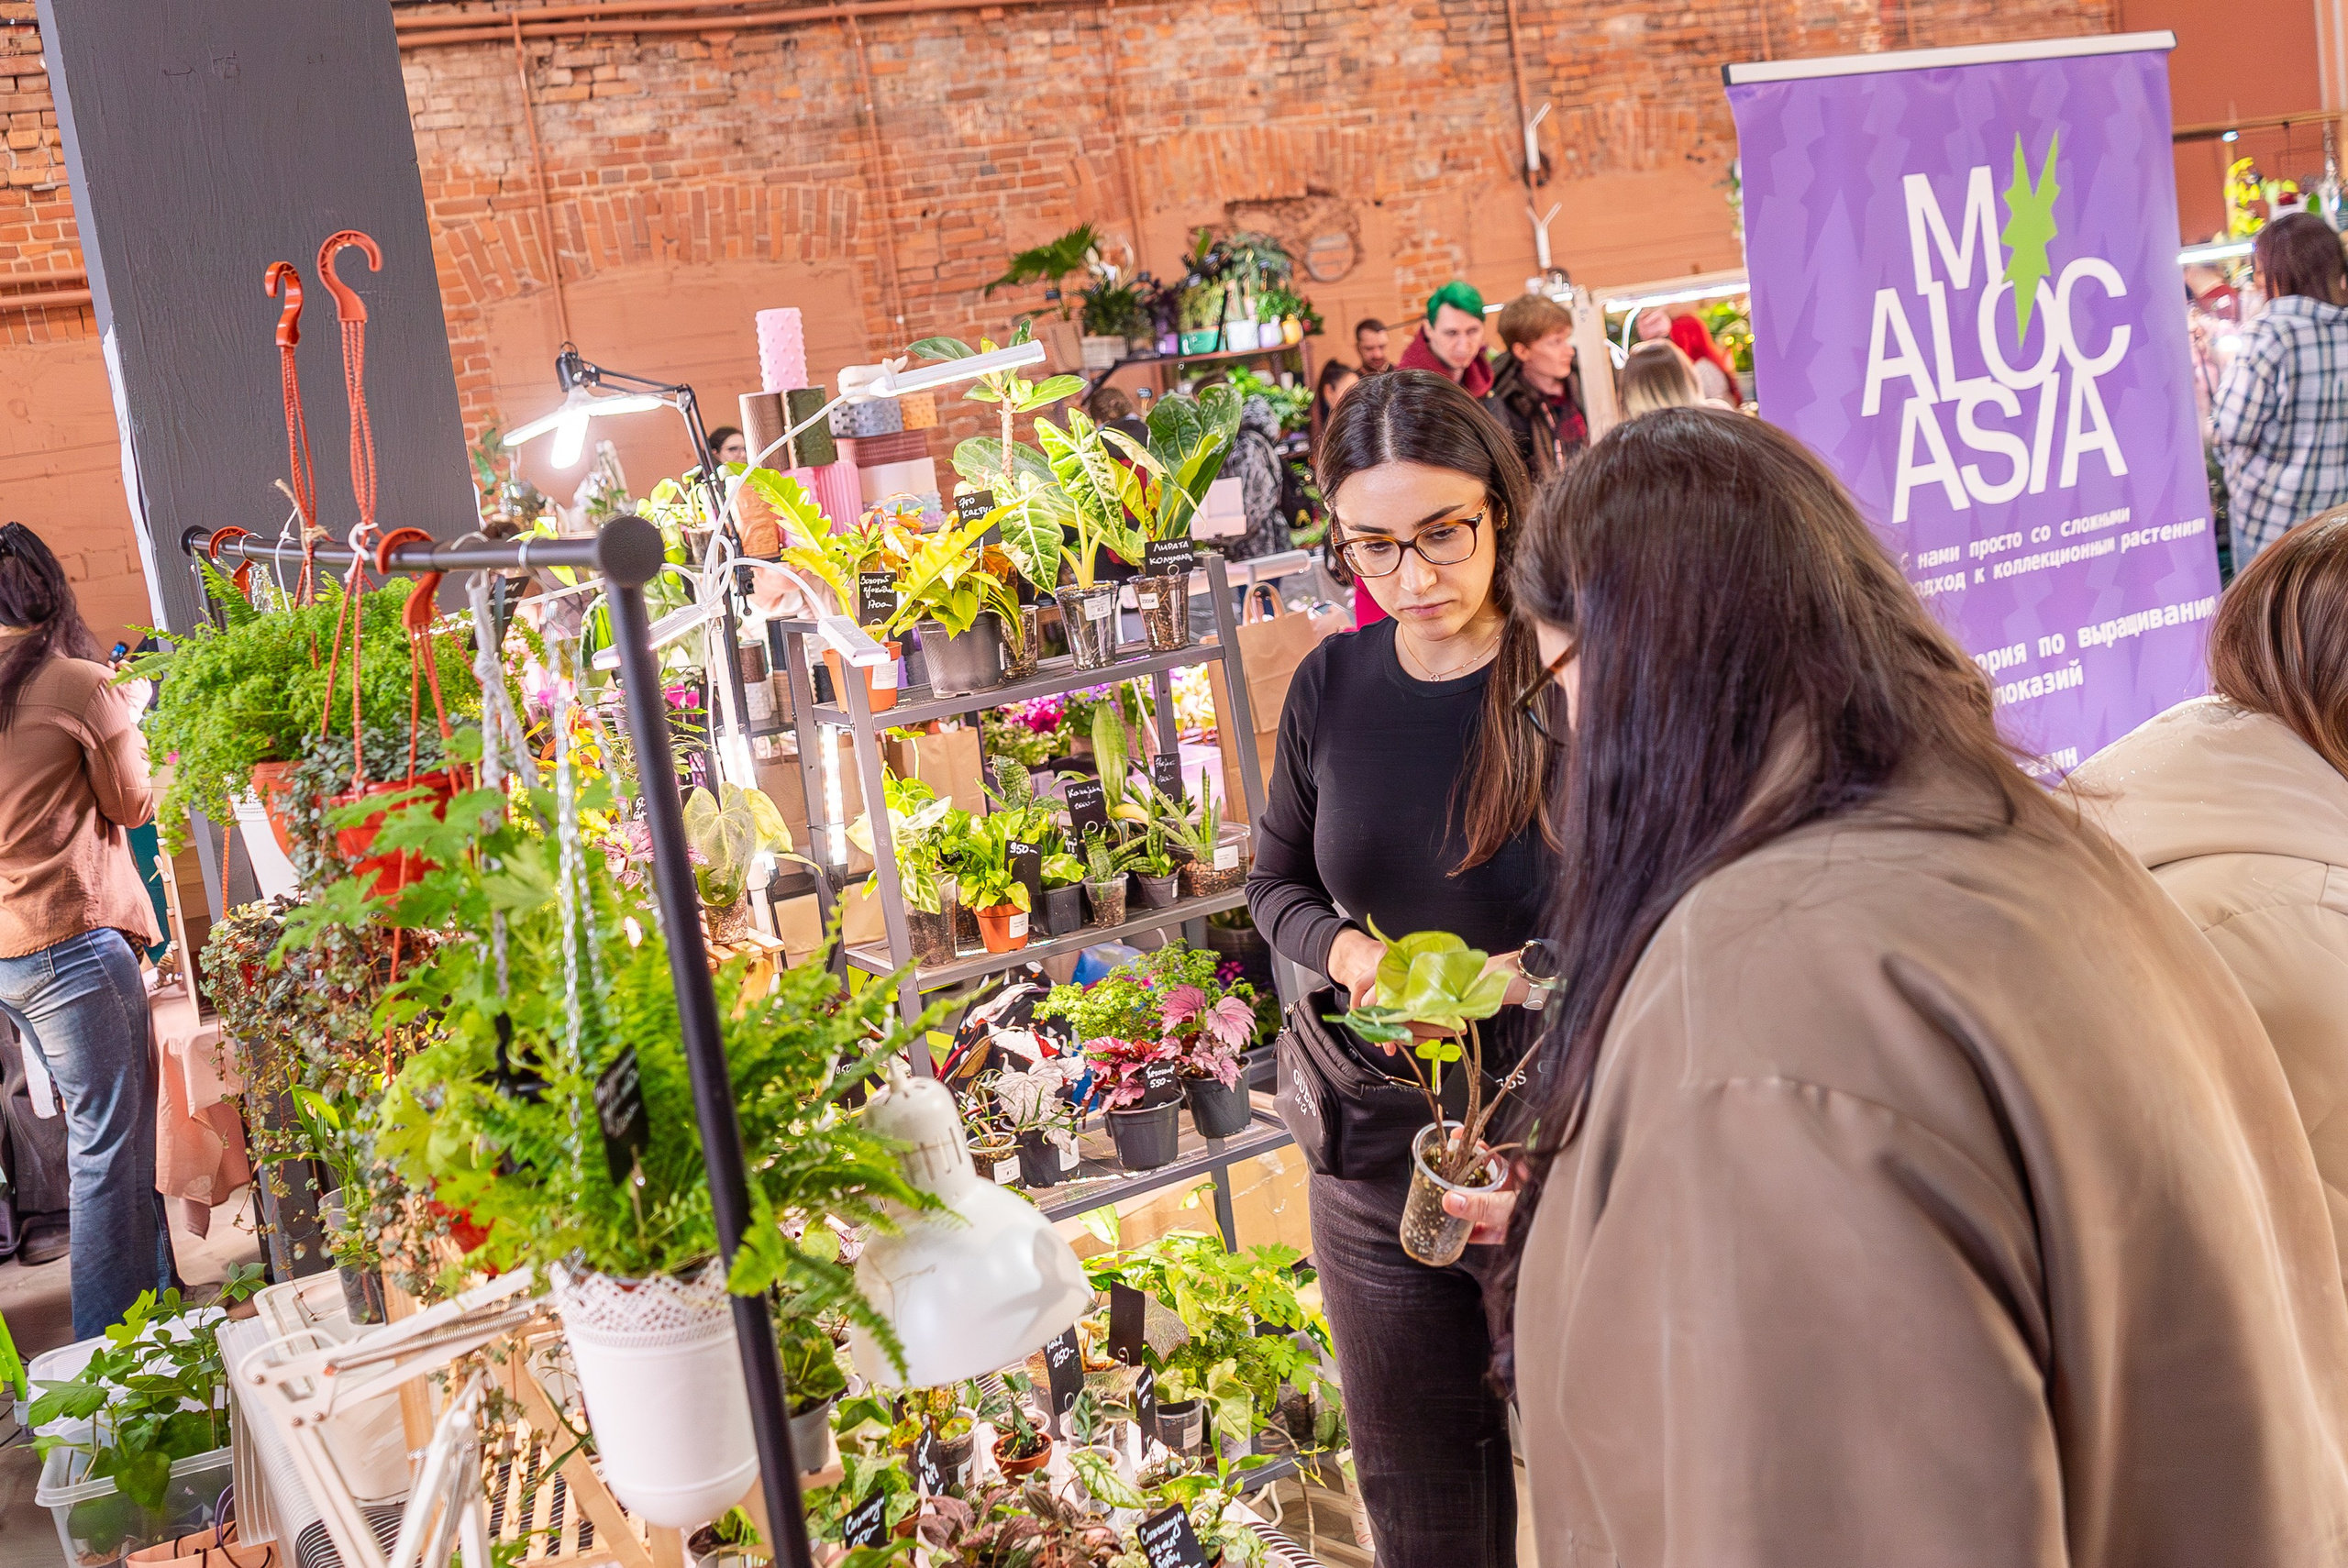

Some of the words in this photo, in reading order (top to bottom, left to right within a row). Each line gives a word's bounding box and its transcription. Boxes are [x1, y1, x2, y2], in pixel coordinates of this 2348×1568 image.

[1892, 369, 2128, 524] ASIA
[1153, 539, 1190, 552] ЛИРАТА
[1917, 545, 1960, 569] нами
[1968, 531, 2023, 561] просто
[2031, 524, 2052, 544] со
[2060, 506, 2132, 537] сложными
[1913, 570, 1966, 599] одход
[1973, 566, 1986, 584] к
[1974, 642, 2028, 677] ория
[2037, 633, 2066, 658] по
